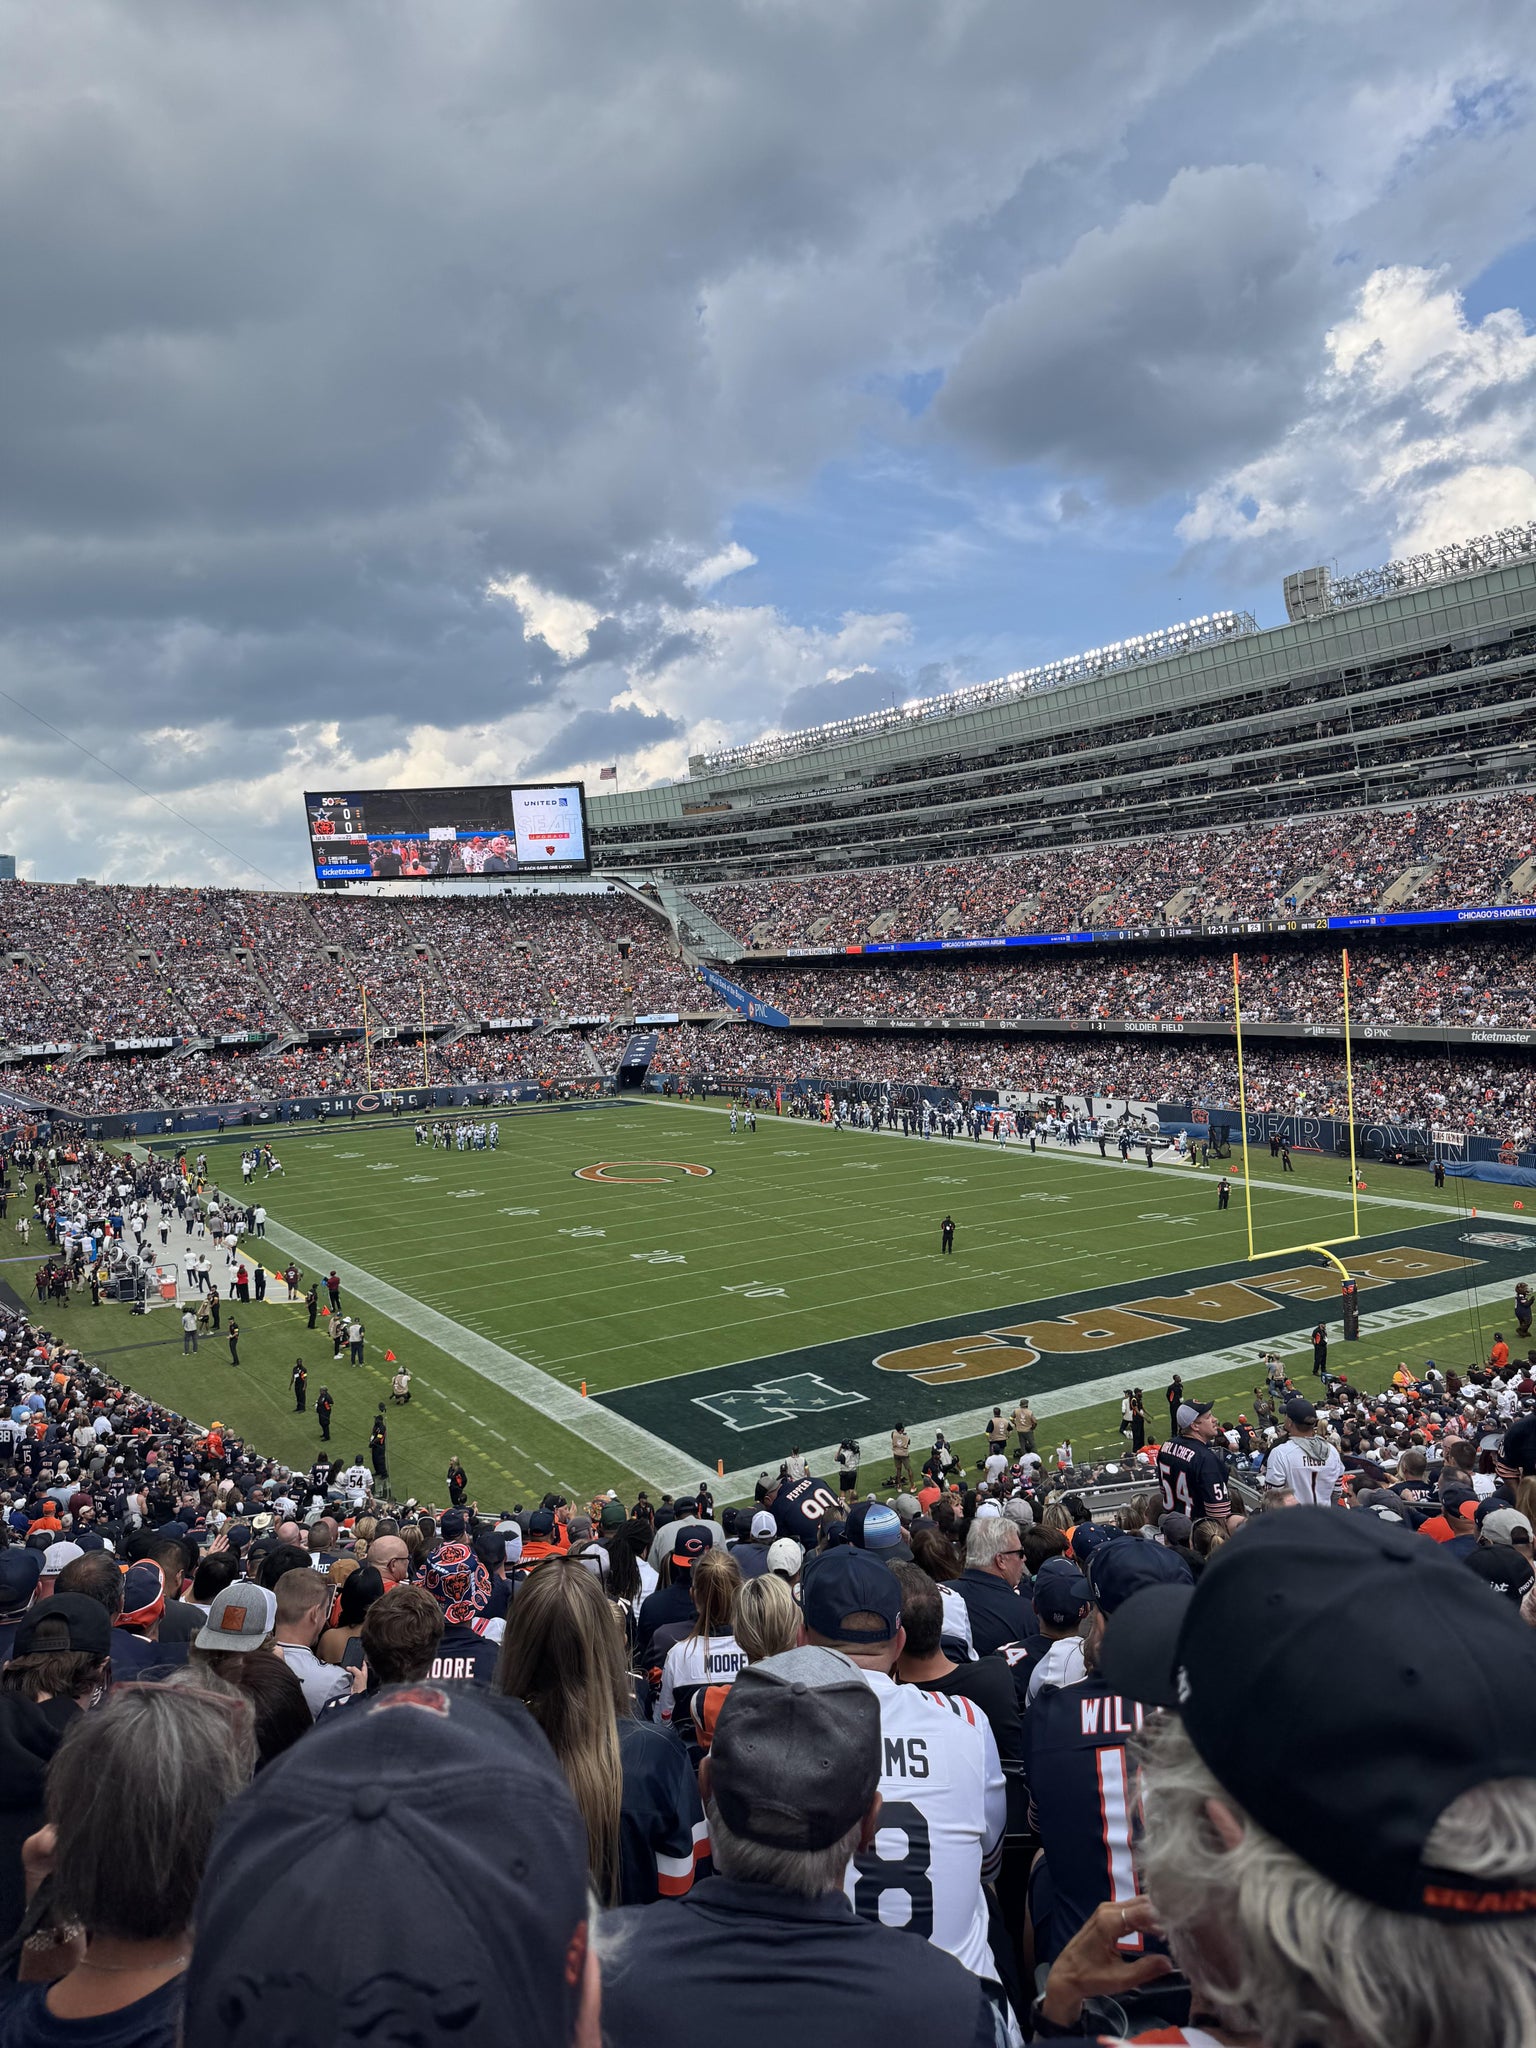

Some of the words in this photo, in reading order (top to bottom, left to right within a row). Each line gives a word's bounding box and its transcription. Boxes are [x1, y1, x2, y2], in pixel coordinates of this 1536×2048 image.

[343, 809, 350, 819] 0
[345, 822, 352, 832] 0
[518, 814, 578, 836] SEAT
[322, 868, 366, 876] ticketmaster
[1287, 920, 1297, 930] 10
[1317, 919, 1327, 929] 23
[1458, 911, 1498, 920] CHICAGO'S
[1119, 931, 1124, 940] 0
[1160, 928, 1166, 937] 0
[1207, 925, 1228, 934] 12:31
[754, 1004, 768, 1018] PNC
[489, 1018, 533, 1028] BEAR
[568, 1015, 610, 1025] DOWN
[1124, 1023, 1157, 1031] SOLDIER
[1161, 1023, 1184, 1032] FIELD
[1374, 1029, 1391, 1037] PNC
[1471, 1031, 1531, 1043] ticketmaster
[19, 1044, 72, 1055] BEAR
[114, 1037, 173, 1049] DOWN
[1244, 1114, 1322, 1149] BEAR
[629, 1249, 689, 1264] 20
[721, 1280, 791, 1299] 10
[871, 1245, 1490, 1386] BEARS
[23, 1450, 32, 1463] 15
[349, 1475, 364, 1489] 54
[786, 1479, 813, 1502] PEPPERS
[1159, 1461, 1194, 1520] 54
[1311, 1471, 1318, 1507] 1
[1213, 1482, 1229, 1501] 54
[801, 1488, 840, 1520] 90
[704, 1653, 747, 1674] MOORE
[880, 1736, 930, 1779] MS
[853, 1800, 934, 1941] 8
